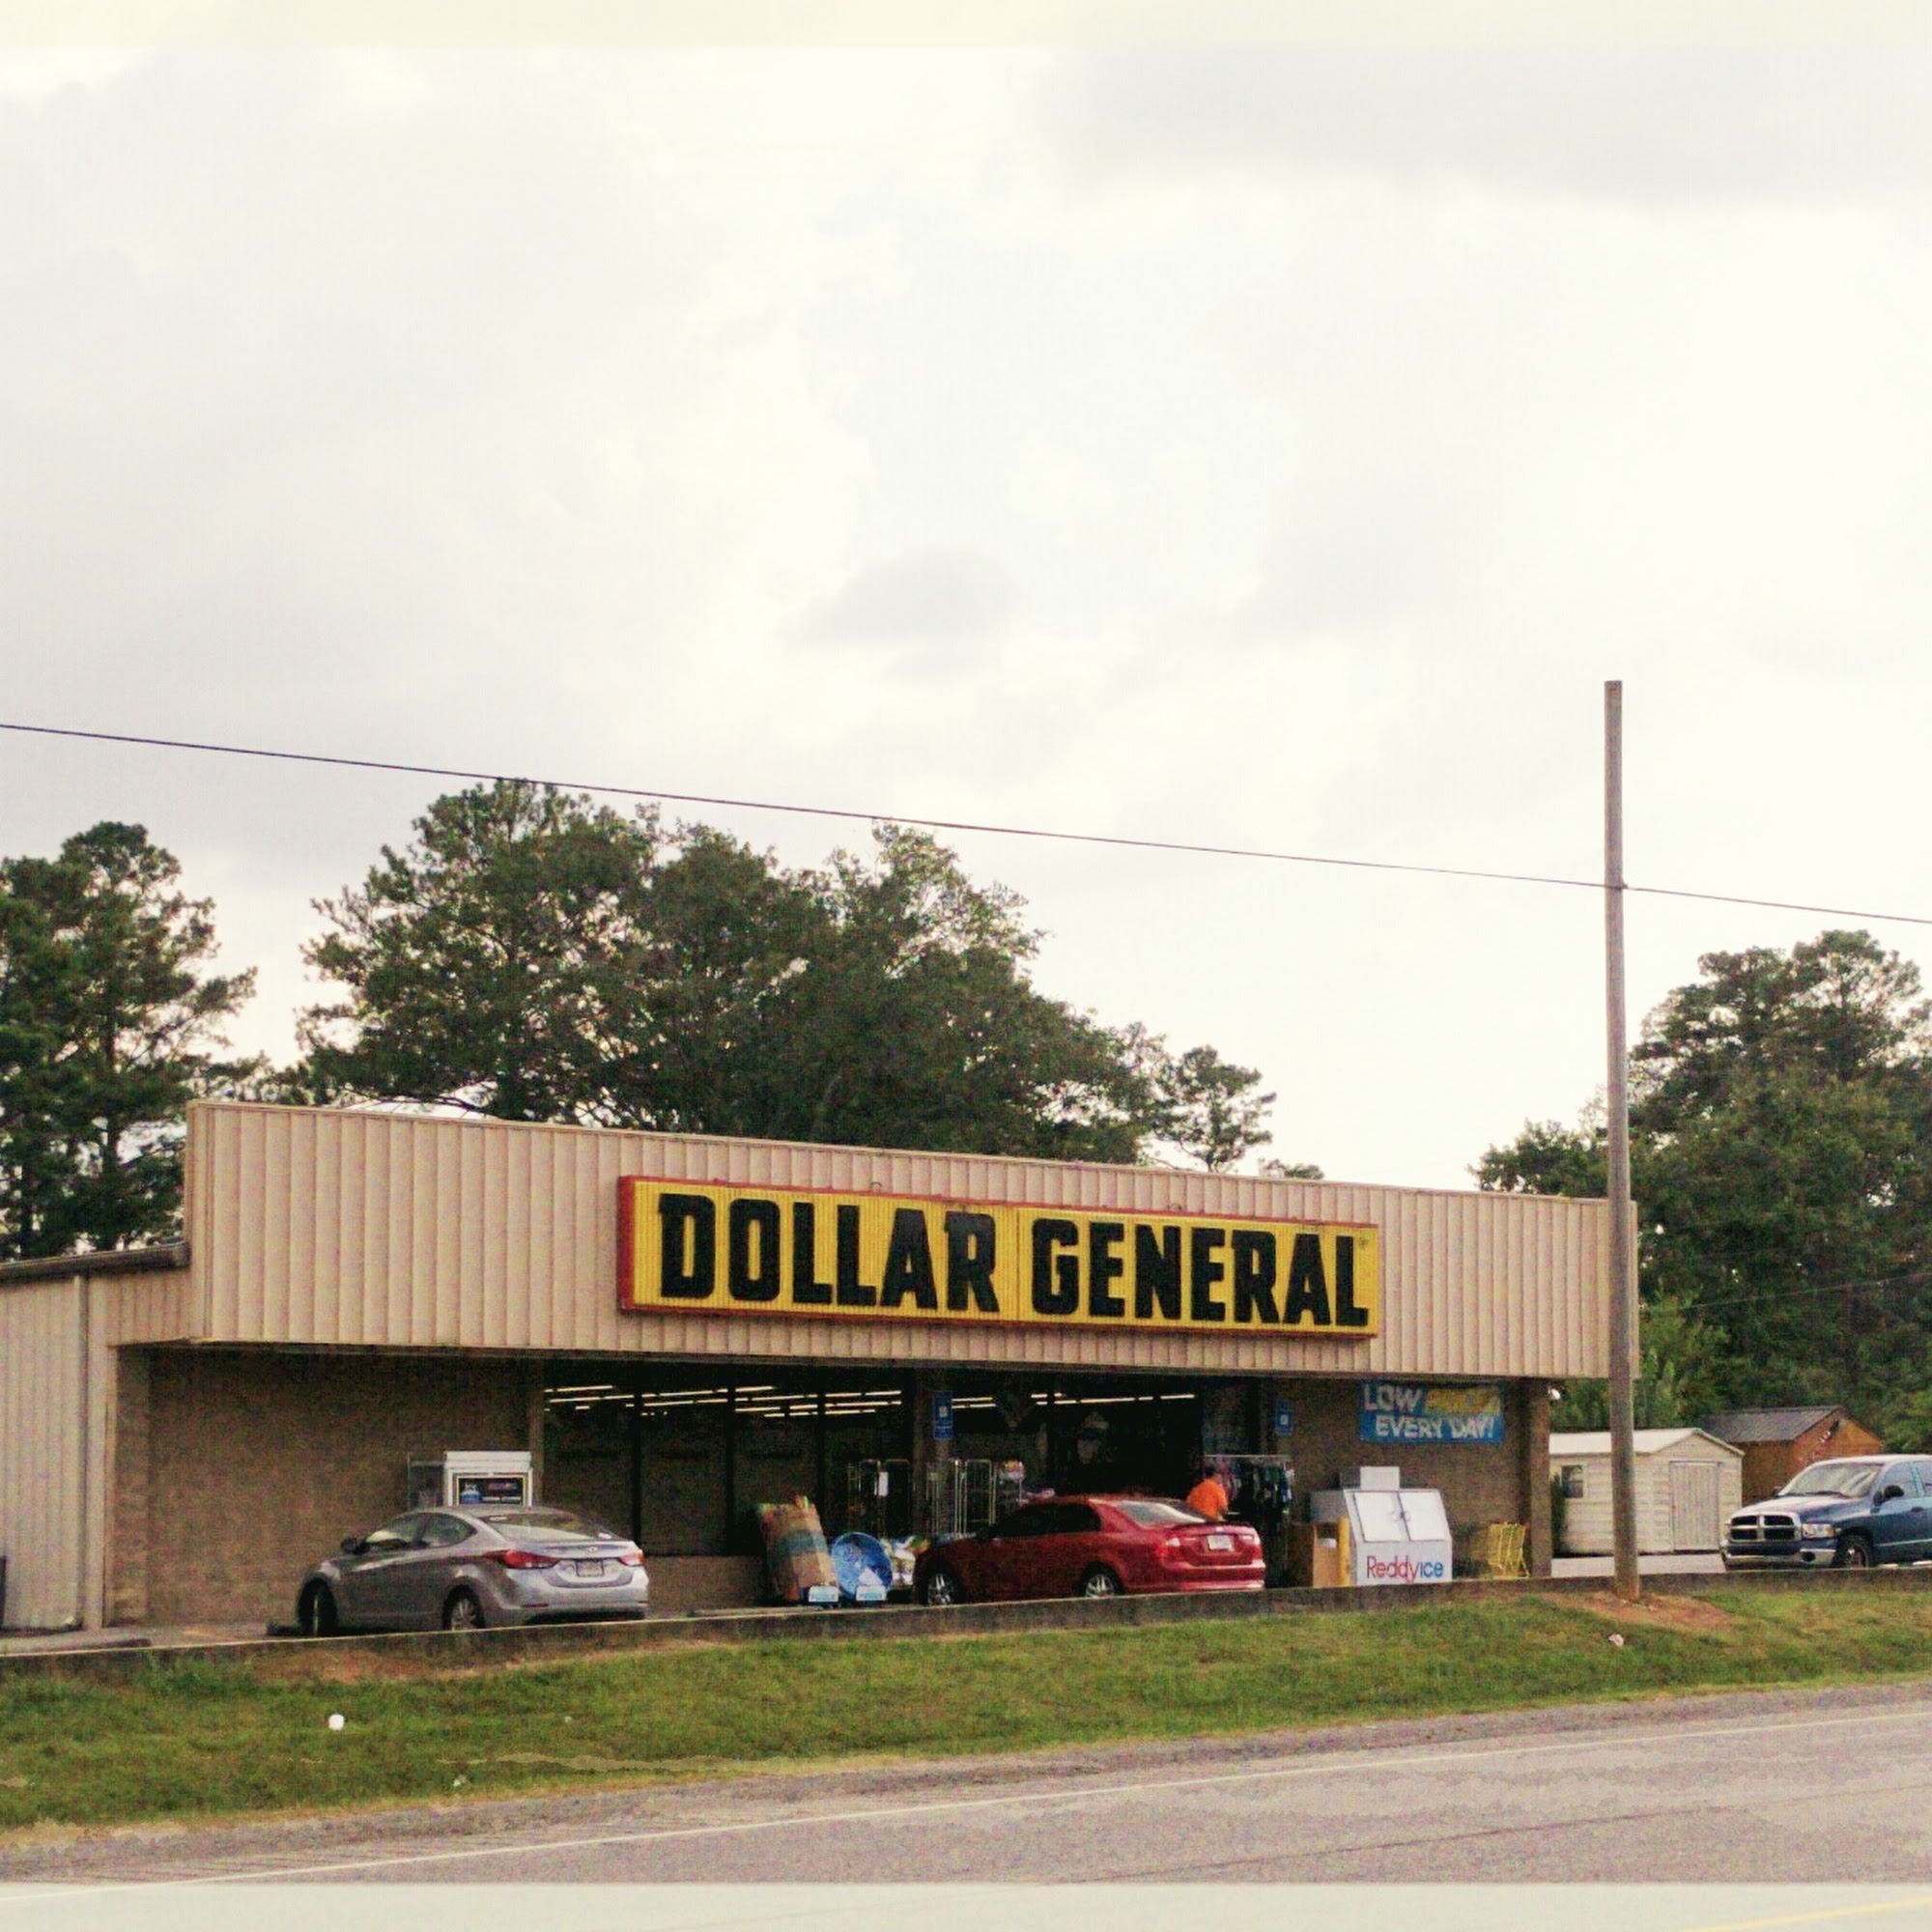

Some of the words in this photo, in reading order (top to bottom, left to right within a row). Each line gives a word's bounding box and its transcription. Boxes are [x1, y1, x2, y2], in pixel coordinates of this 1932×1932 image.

[659, 1193, 1000, 1312] DOLLAR
[1032, 1218, 1368, 1326] GENERAL
[1364, 1382, 1422, 1413] LOW
[1376, 1414, 1442, 1438] EVERY
